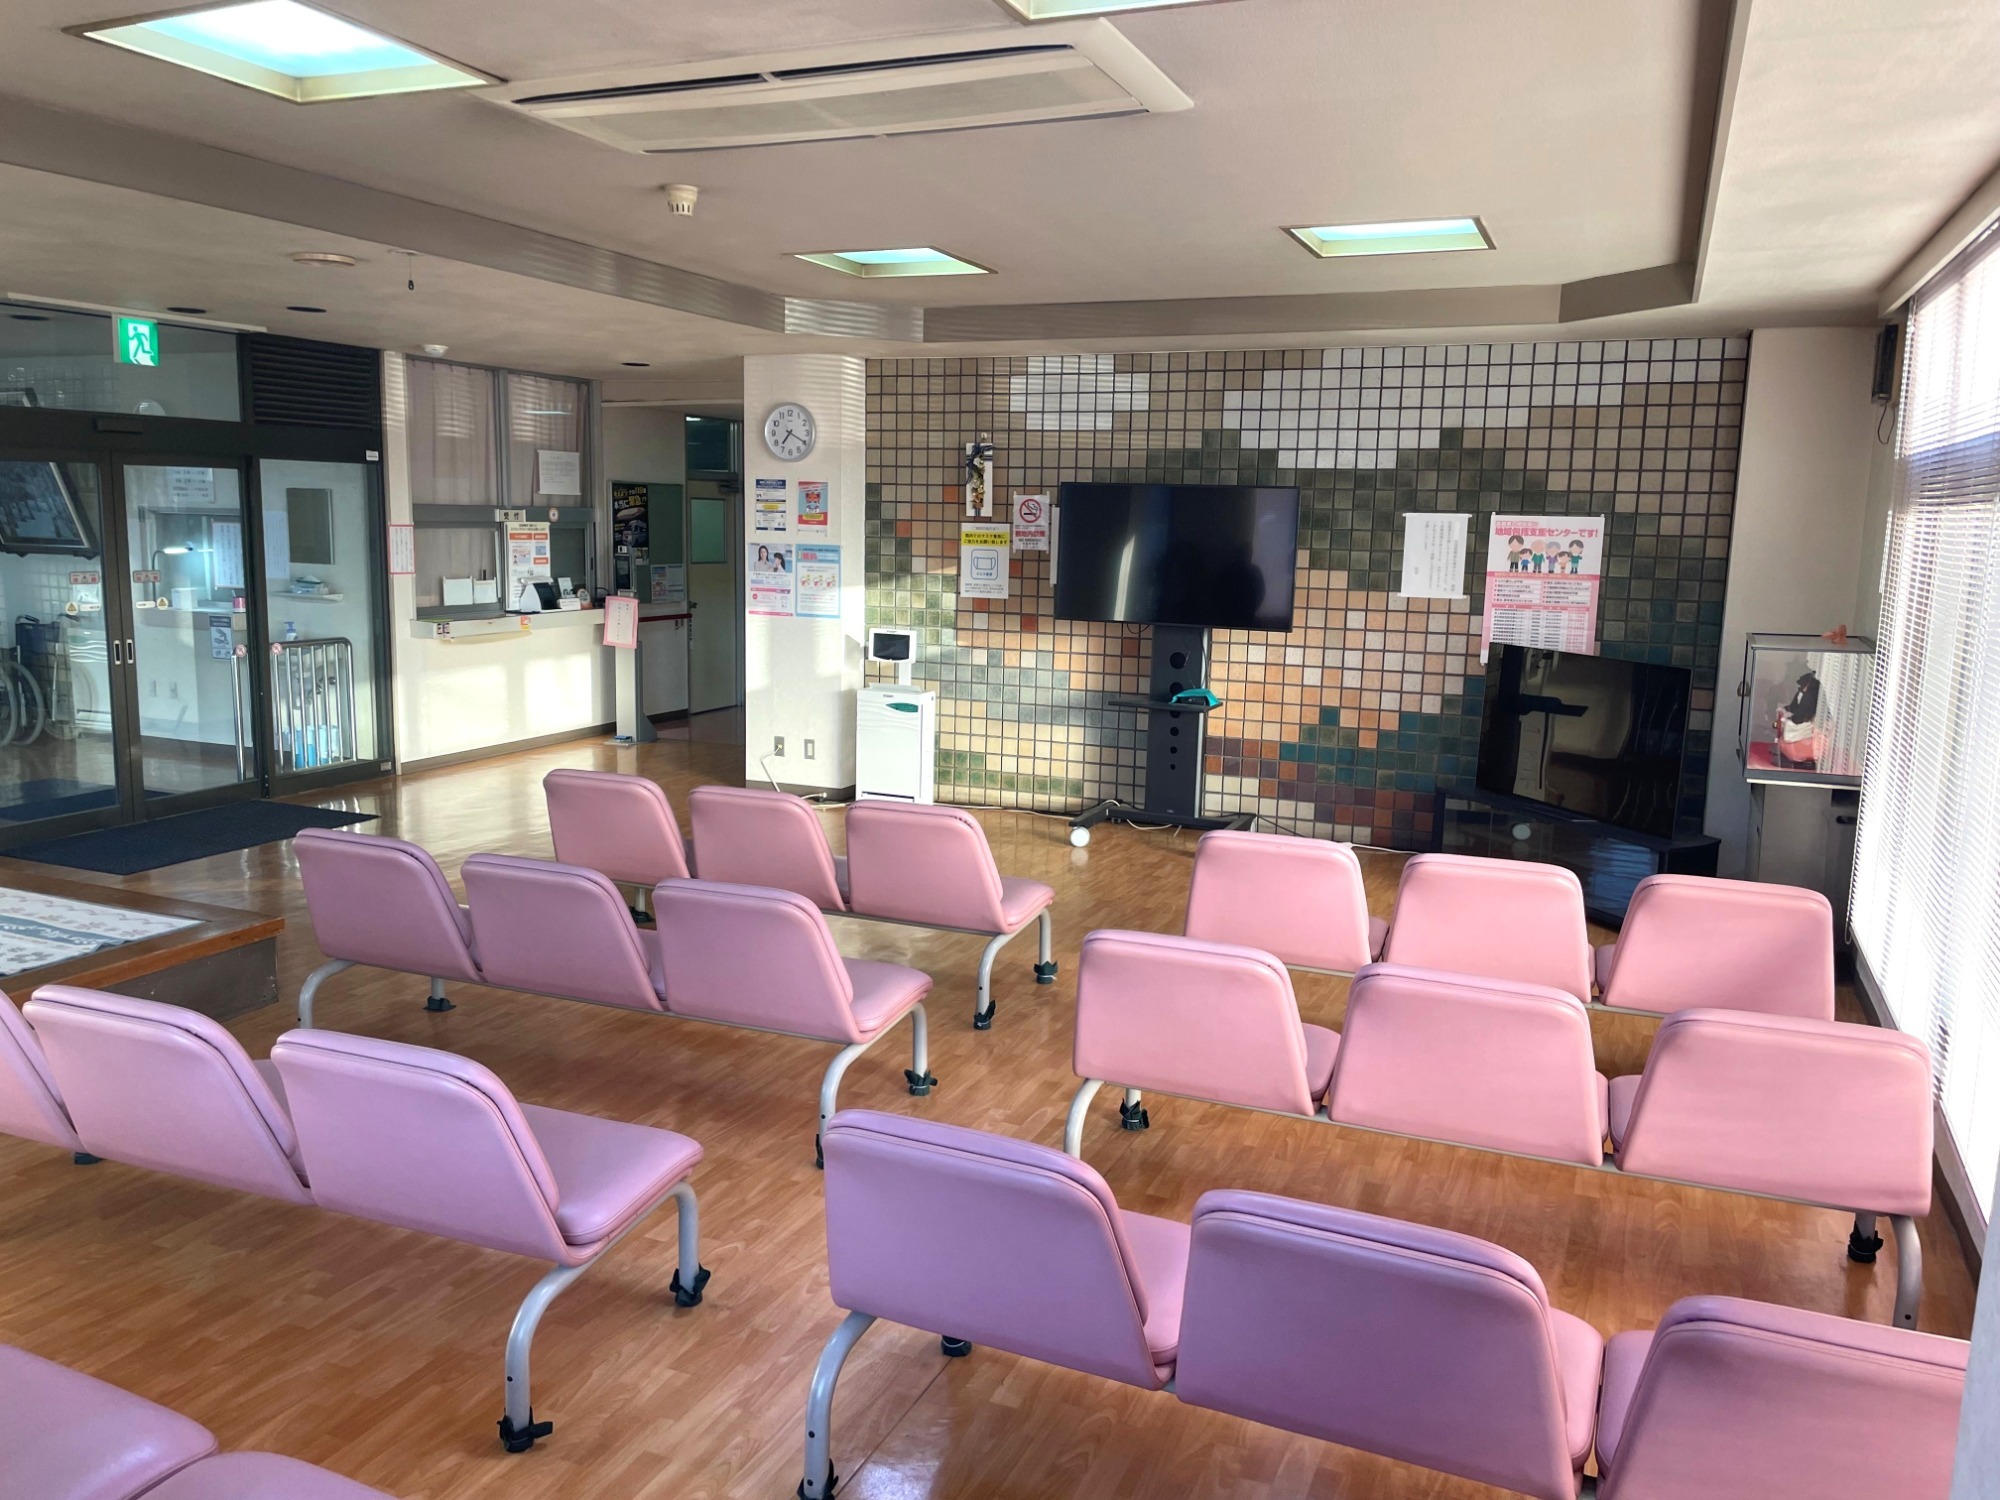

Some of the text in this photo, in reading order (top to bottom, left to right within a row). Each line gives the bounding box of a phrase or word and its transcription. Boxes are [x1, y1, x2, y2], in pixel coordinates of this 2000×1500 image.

[779, 411, 785, 420] 11
[802, 419, 807, 427] 2
[771, 429, 776, 437] 9
[804, 429, 809, 437] 3
[774, 439, 779, 447] 8
[780, 446, 785, 454] 7
[796, 446, 801, 454] 5
